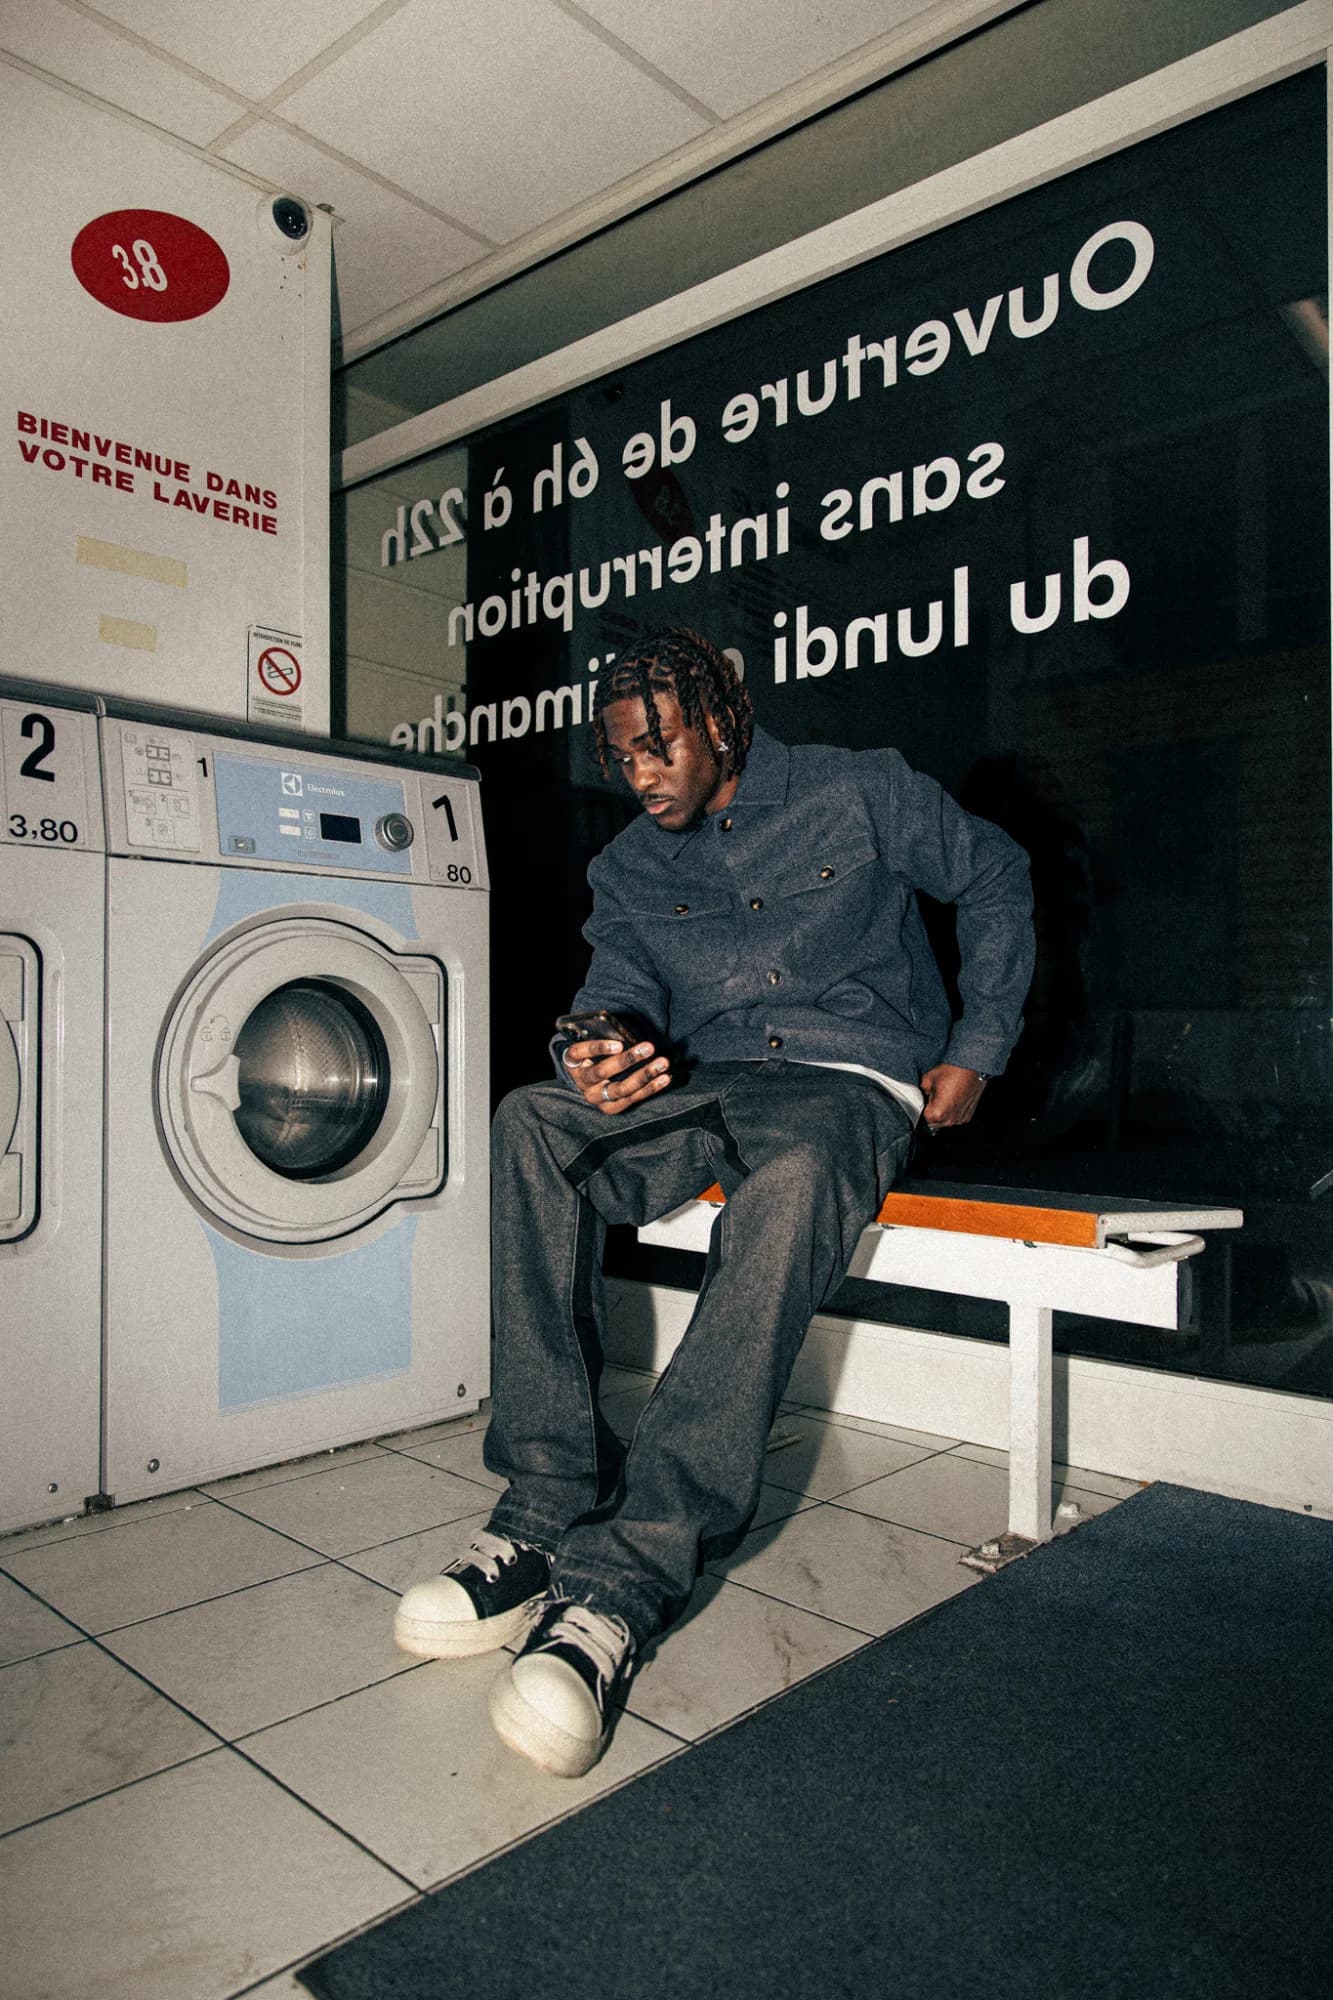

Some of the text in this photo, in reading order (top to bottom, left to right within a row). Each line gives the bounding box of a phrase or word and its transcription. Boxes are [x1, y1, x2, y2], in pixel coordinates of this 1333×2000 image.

[18, 411, 278, 509] BIENVENUE DANS
[19, 440, 278, 535] VOTRE LAVERIE
[20, 712, 55, 783] 2
[197, 757, 208, 778] 1
[9, 814, 78, 844] 3,80
[431, 794, 459, 842] 1
[447, 864, 472, 884] 80
